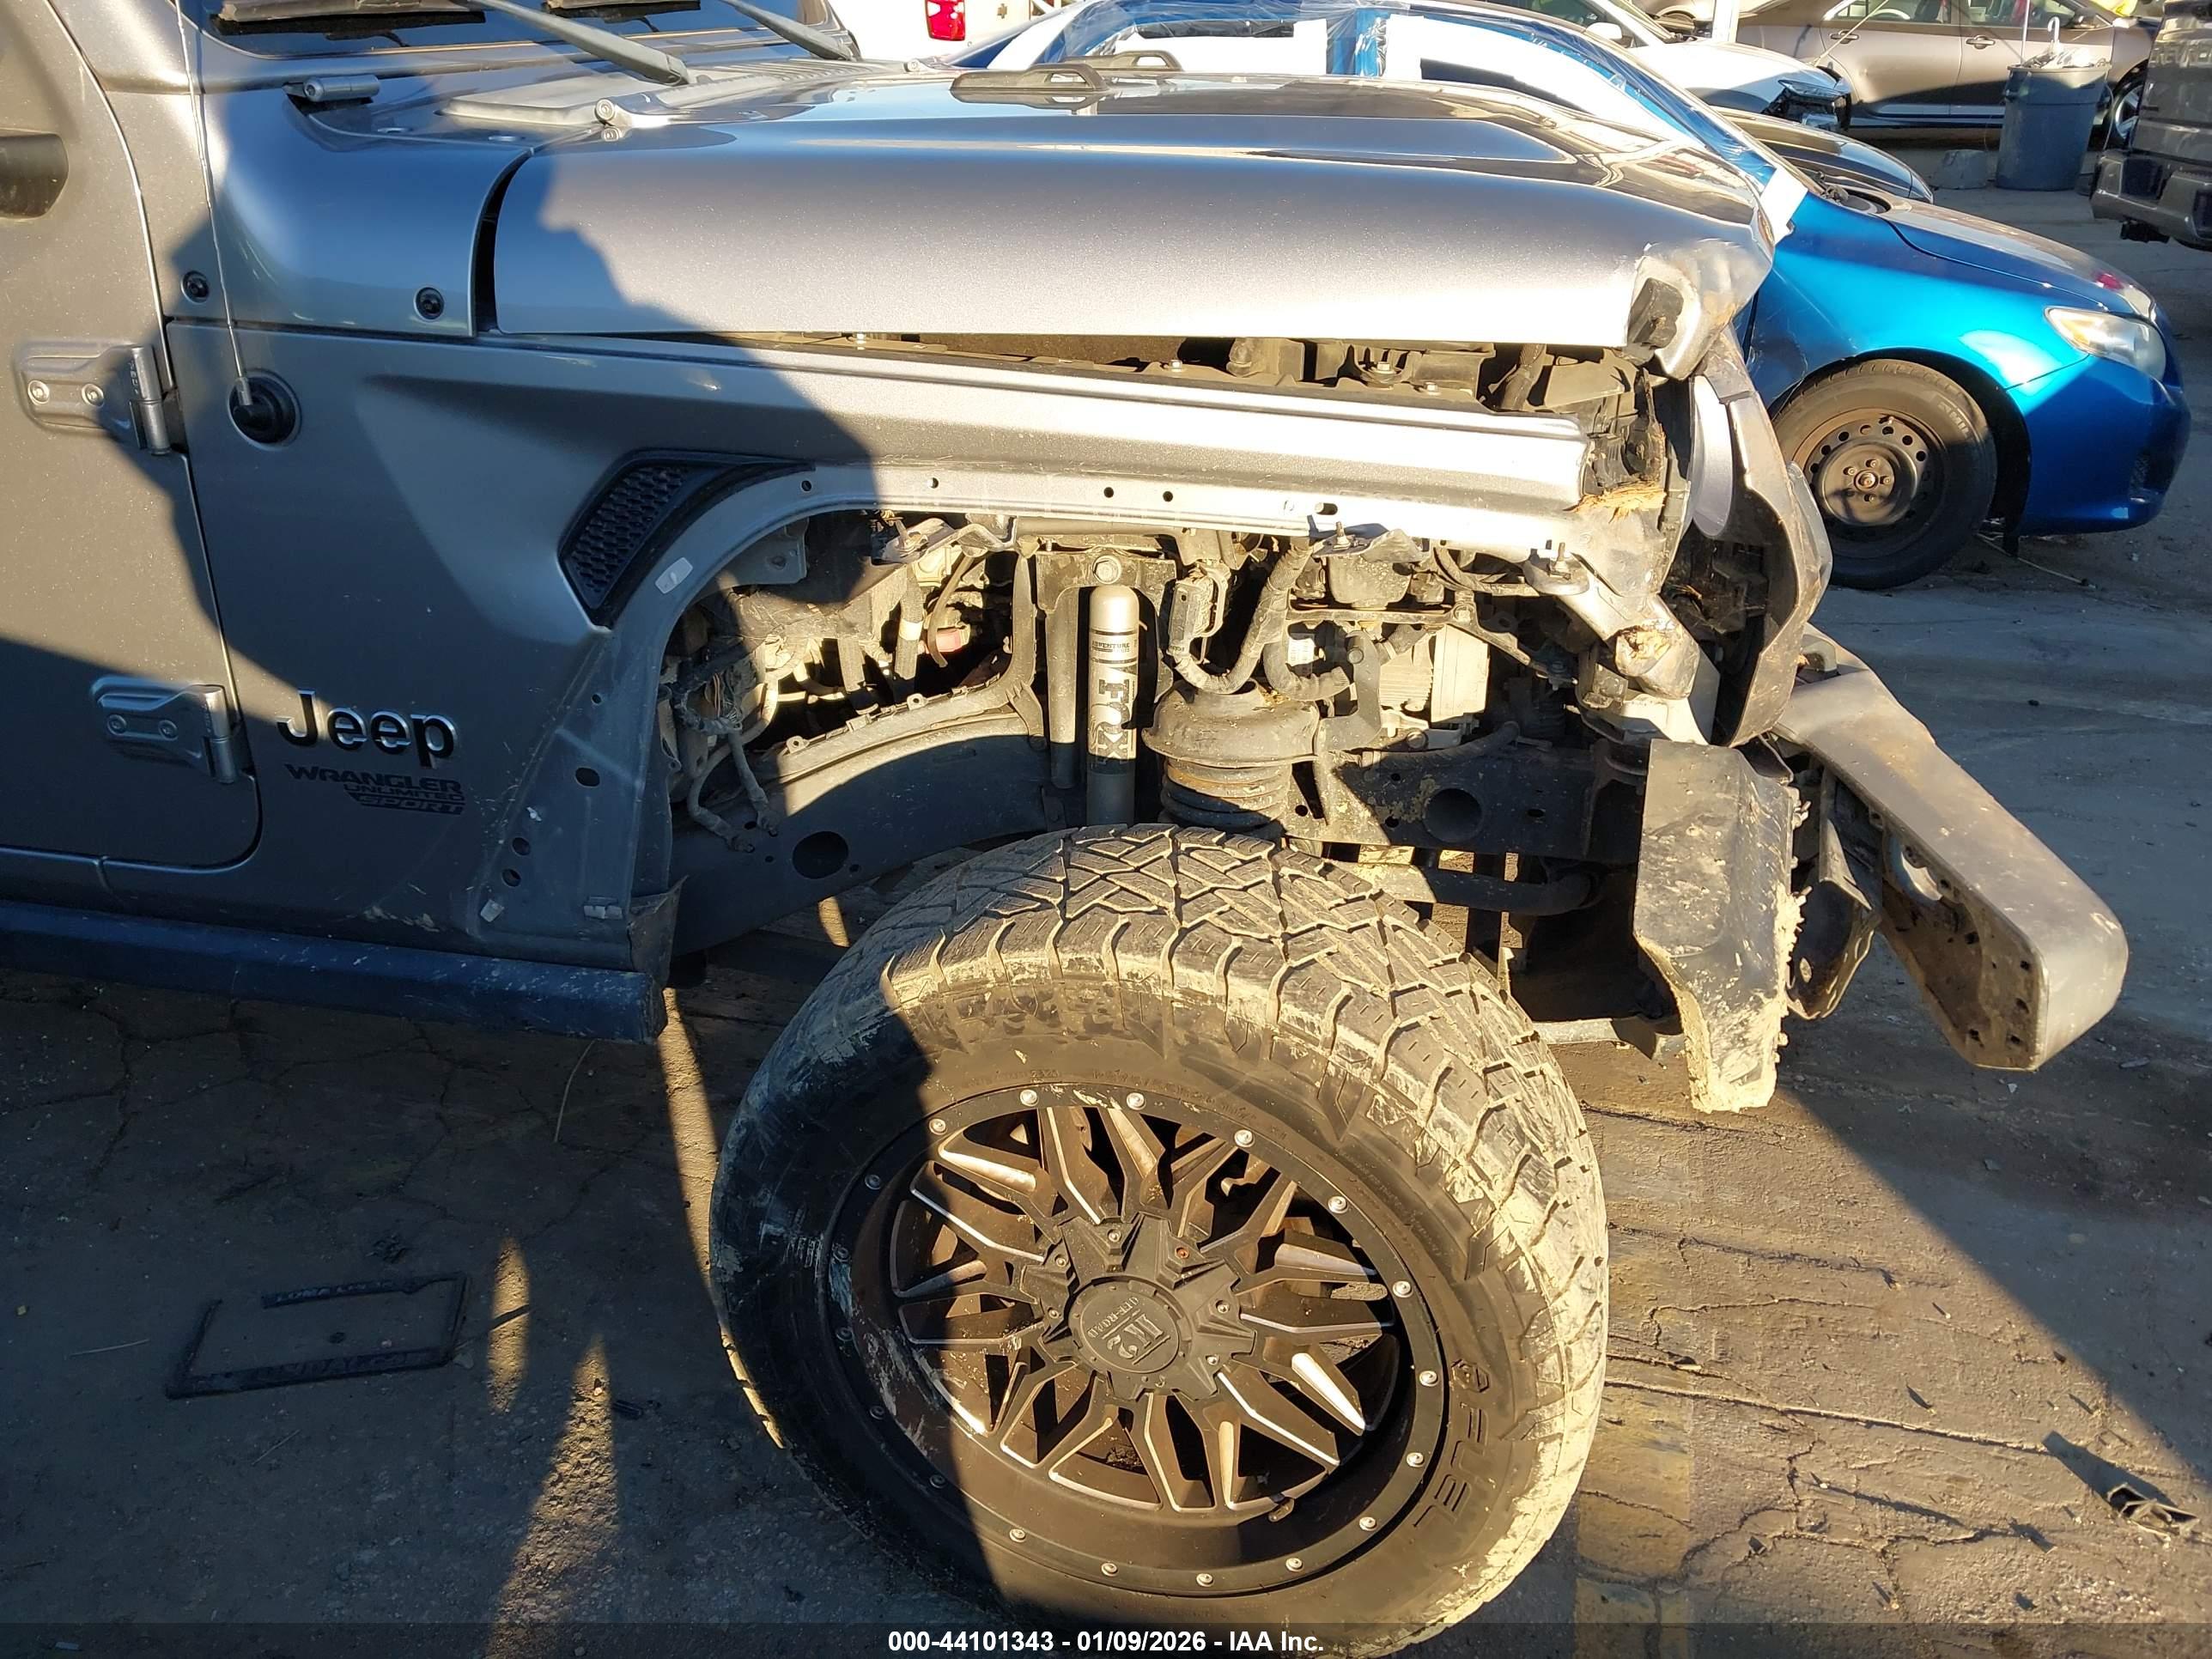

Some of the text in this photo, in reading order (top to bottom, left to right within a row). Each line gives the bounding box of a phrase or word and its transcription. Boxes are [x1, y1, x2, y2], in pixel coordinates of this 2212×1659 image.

[276, 690, 458, 768] Jeep
[1097, 678, 1131, 764] FOX
[284, 763, 463, 794] WRANGLER
[343, 783, 465, 800] UNLIMITED
[356, 795, 464, 814] SPORT
[1087, 1297, 1140, 1339] OFF-ROAD
[1106, 1313, 1164, 1359] K2
[1413, 1401, 1490, 1527] FUEL
